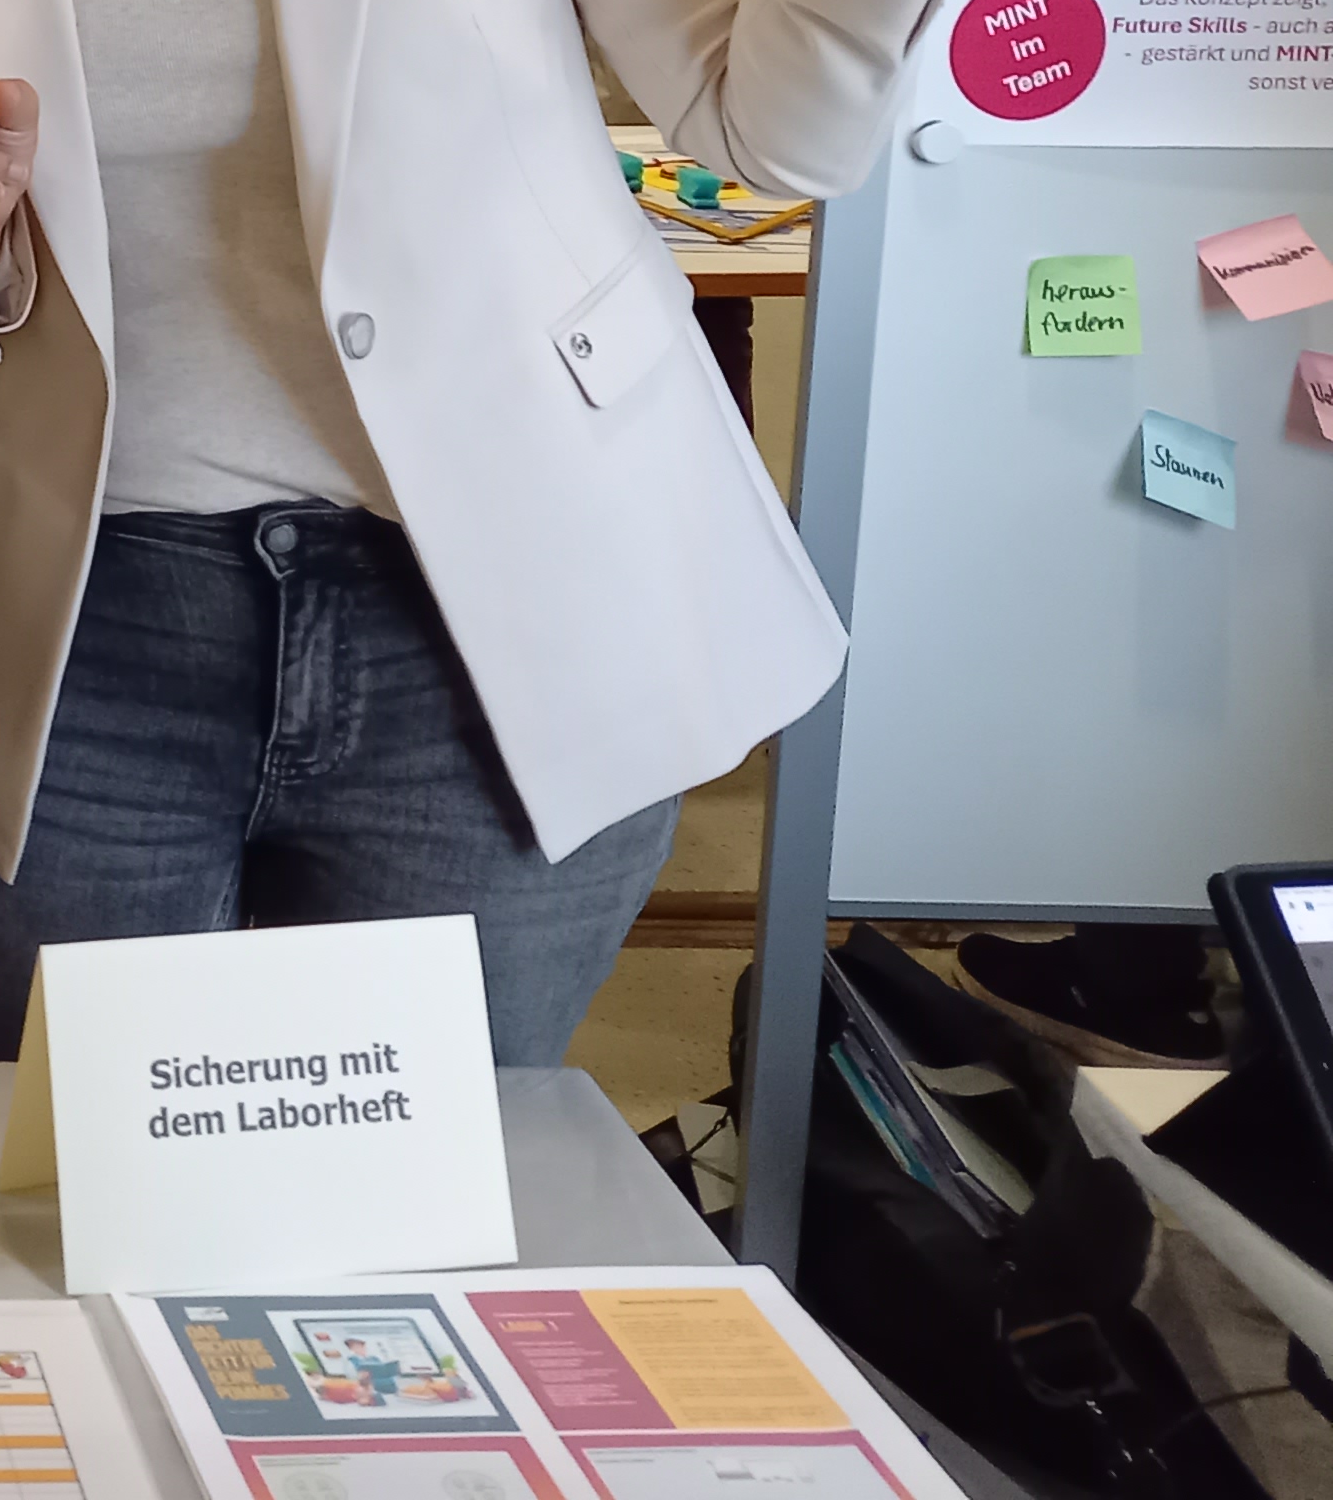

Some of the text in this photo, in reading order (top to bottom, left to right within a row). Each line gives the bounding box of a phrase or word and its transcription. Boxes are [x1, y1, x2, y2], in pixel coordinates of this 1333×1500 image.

[1113, 18, 1182, 34] Future
[1187, 17, 1247, 34] Skills
[1266, 18, 1318, 34] auch
[1009, 36, 1046, 61] im
[1141, 46, 1269, 65] gestärkt und
[1002, 58, 1072, 97] Team
[1248, 75, 1305, 91] sonst
[1150, 444, 1225, 490] Staunen
[150, 1042, 400, 1090] Sicherung mit
[149, 1089, 412, 1139] dem Laborheft
